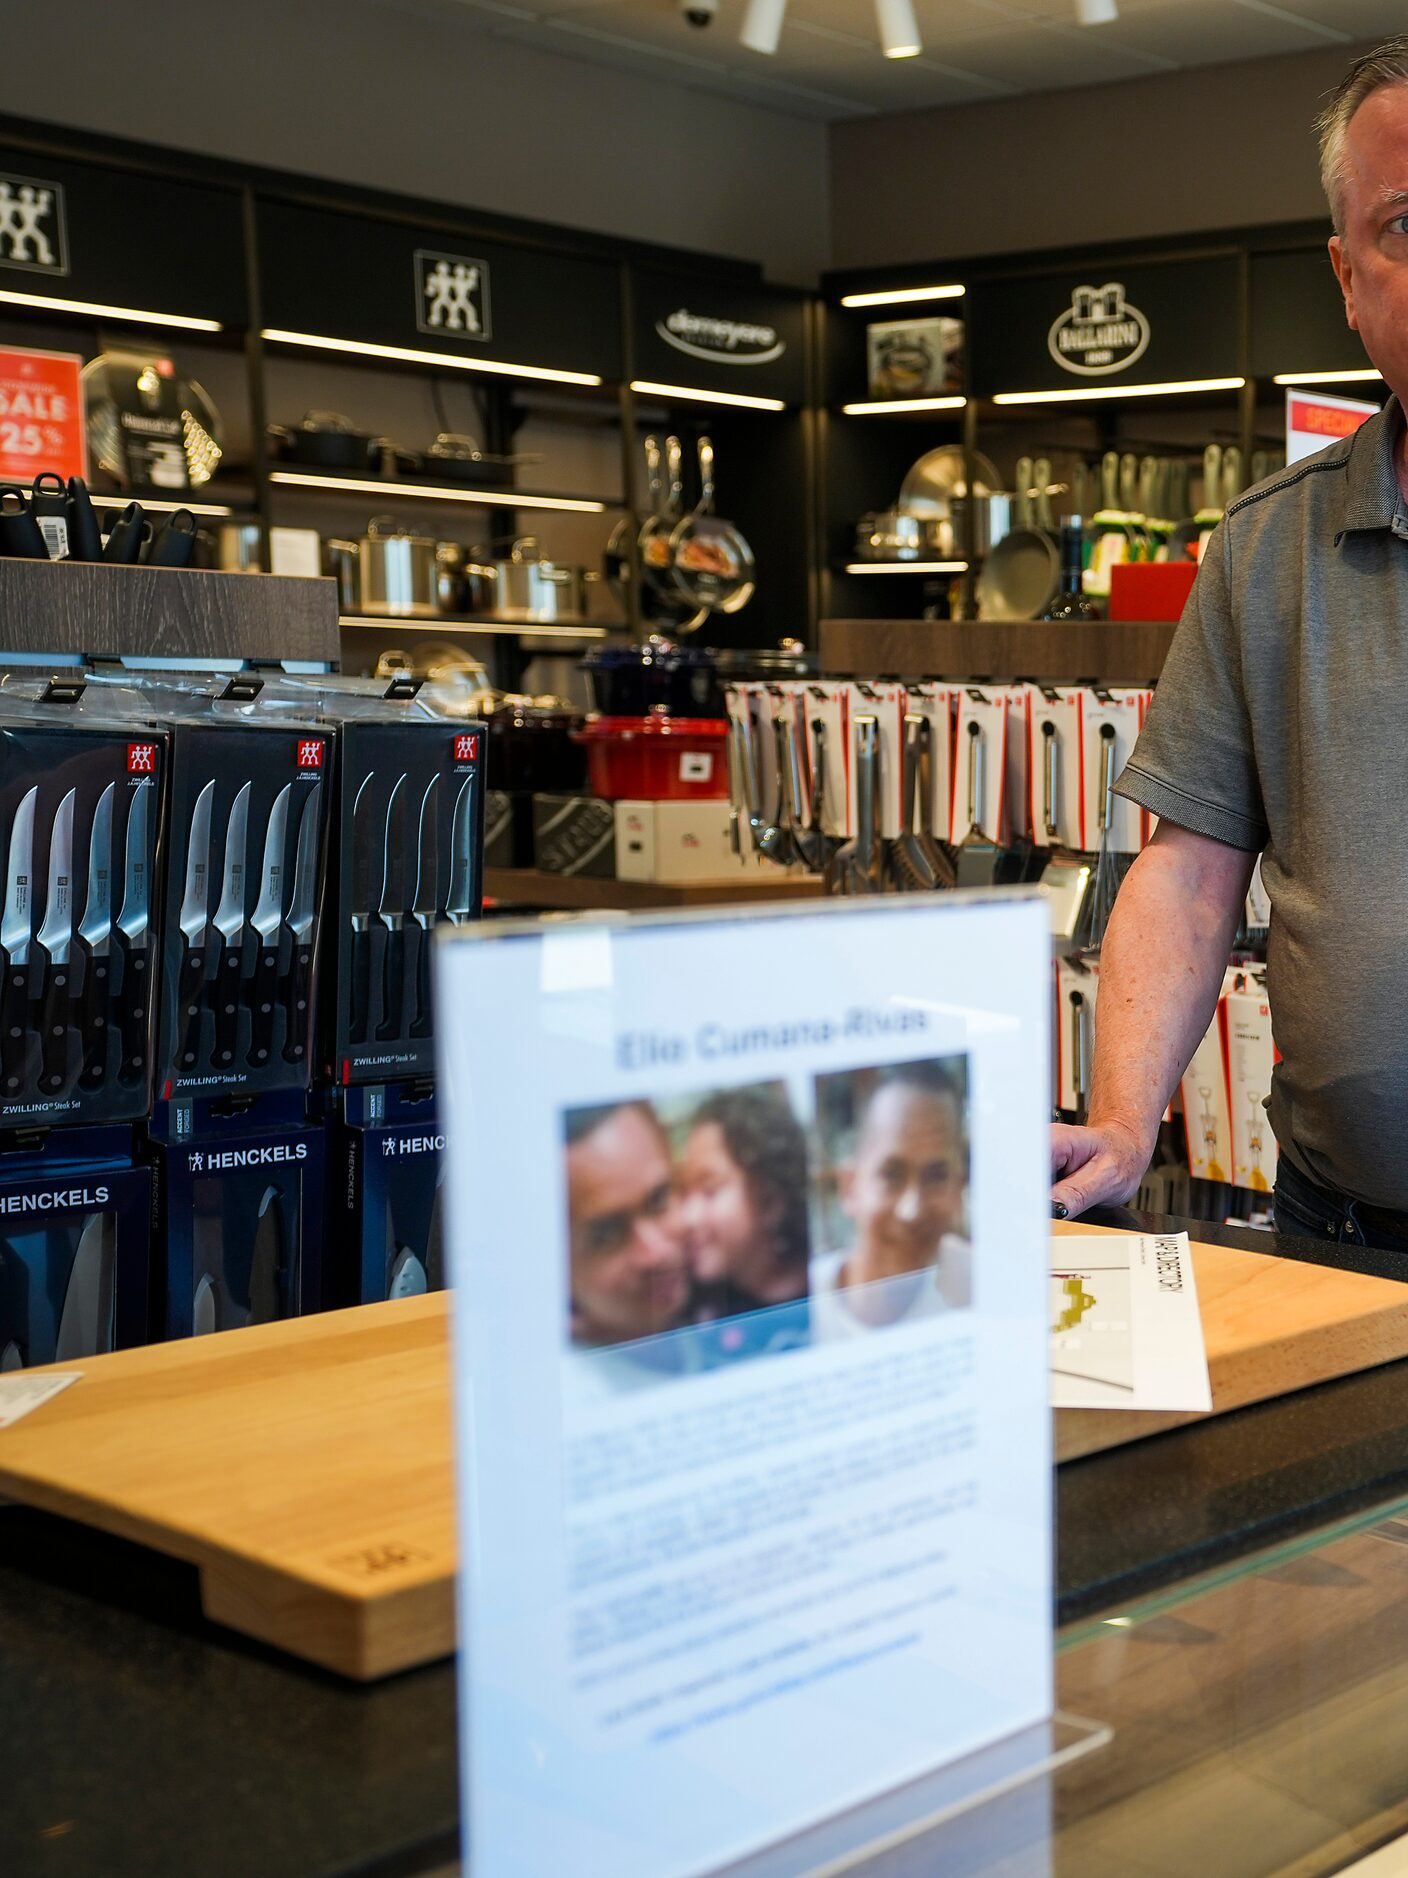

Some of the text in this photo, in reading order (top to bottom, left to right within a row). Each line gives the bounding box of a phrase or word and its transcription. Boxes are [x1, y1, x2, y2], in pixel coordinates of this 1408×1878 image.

[223, 1074, 237, 1084] Steak
[238, 1074, 247, 1083] Set
[54, 1101, 71, 1111] Steak
[72, 1100, 81, 1110] Set
[399, 1137, 448, 1155] HENC
[208, 1143, 307, 1170] HENCKELS
